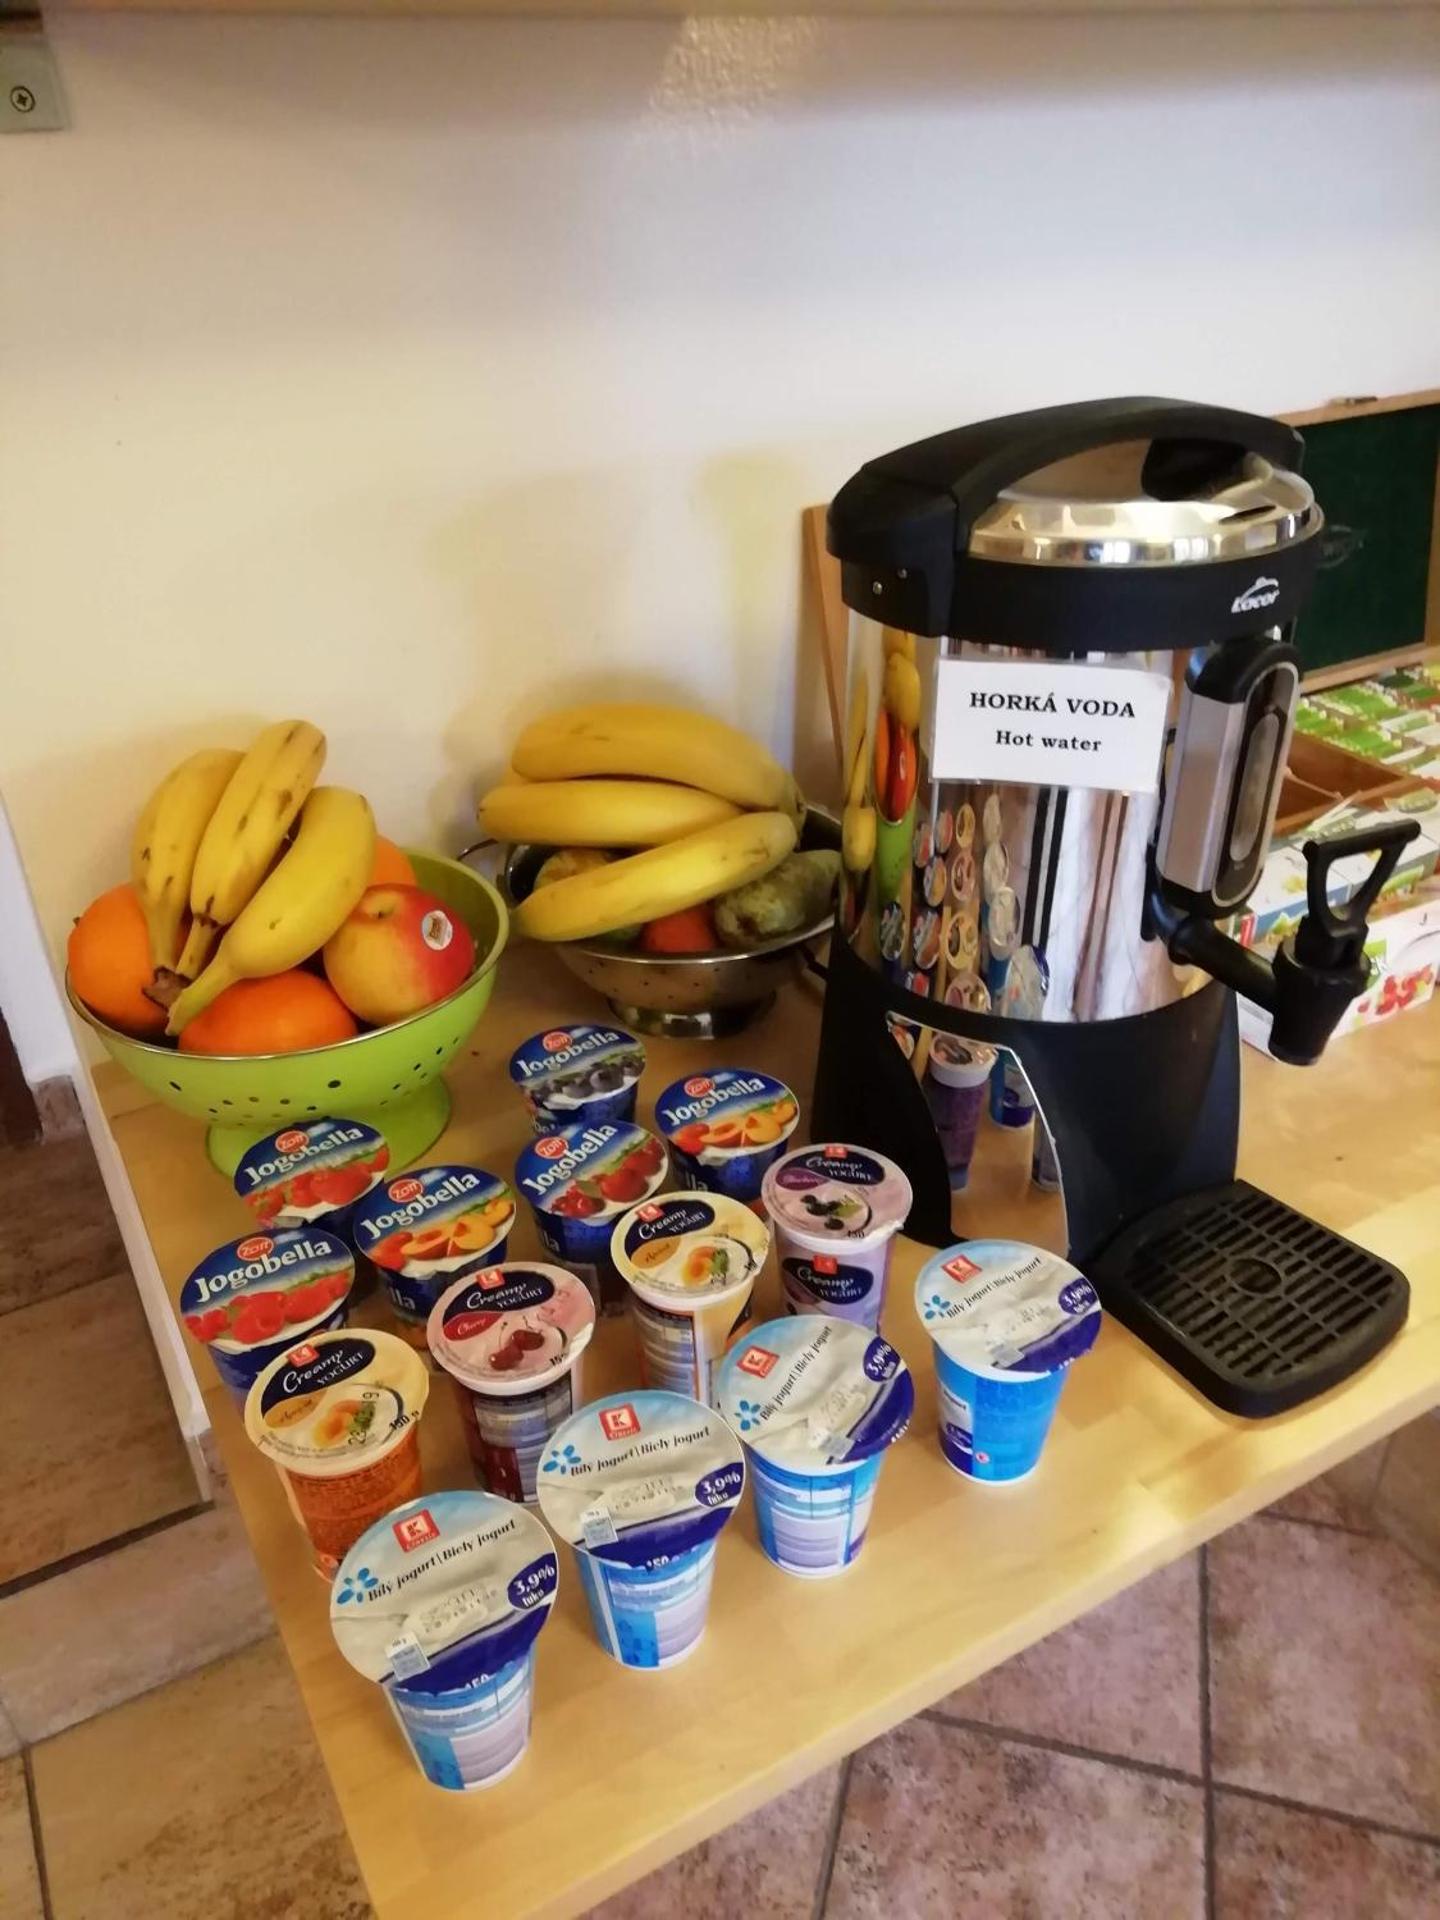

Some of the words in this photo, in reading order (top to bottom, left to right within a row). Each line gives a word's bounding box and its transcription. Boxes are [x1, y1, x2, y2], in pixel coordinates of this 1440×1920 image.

[969, 692, 1057, 713] HORKÁ
[1066, 698, 1136, 718] VODA
[996, 730, 1034, 747] Hot
[1041, 736, 1102, 752] water
[517, 1031, 620, 1077] Jogobella
[662, 1078, 766, 1126] Jogobella
[244, 1128, 365, 1186] Jogobella
[523, 1125, 618, 1195] Jogobella
[360, 1174, 481, 1239] Jogobella
[639, 1209, 687, 1240] Creamy
[195, 1240, 332, 1303] Jogobella
[467, 1283, 527, 1309] Creamy
[283, 1350, 344, 1394] Creamy
[317, 1352, 364, 1385] YOGURT
[597, 1448, 634, 1472] jogurt
[673, 1426, 710, 1447] jogurt
[701, 1470, 741, 1495] 3,9%
[397, 1557, 435, 1590] jogurt
[443, 1541, 473, 1560] Biely
[477, 1519, 515, 1547] jogurt
[513, 1564, 555, 1596] 3,9%
